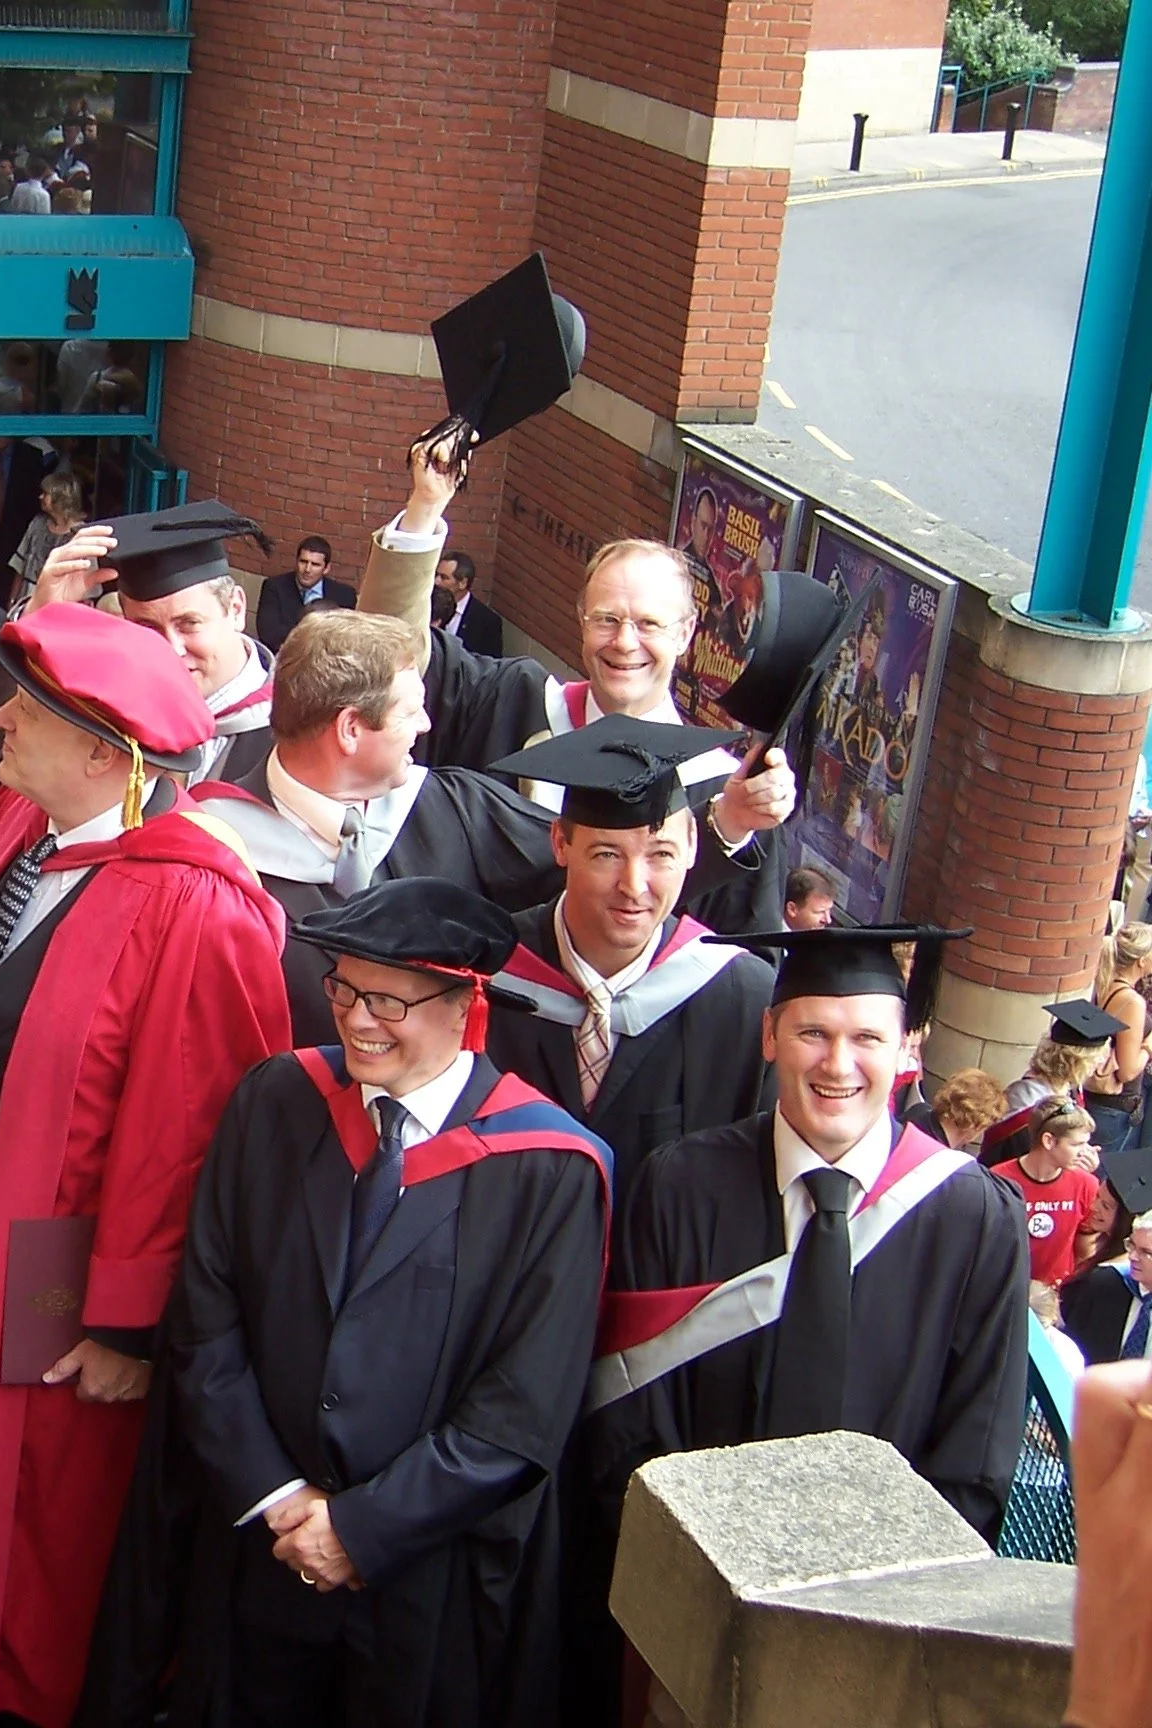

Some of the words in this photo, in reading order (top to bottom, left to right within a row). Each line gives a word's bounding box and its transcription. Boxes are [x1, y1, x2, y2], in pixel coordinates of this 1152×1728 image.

[535, 508, 601, 564] THEATR
[727, 504, 762, 539] BASIL
[723, 524, 759, 559] BRUSH
[908, 596, 936, 620] ROSA
[911, 583, 937, 608] CARL
